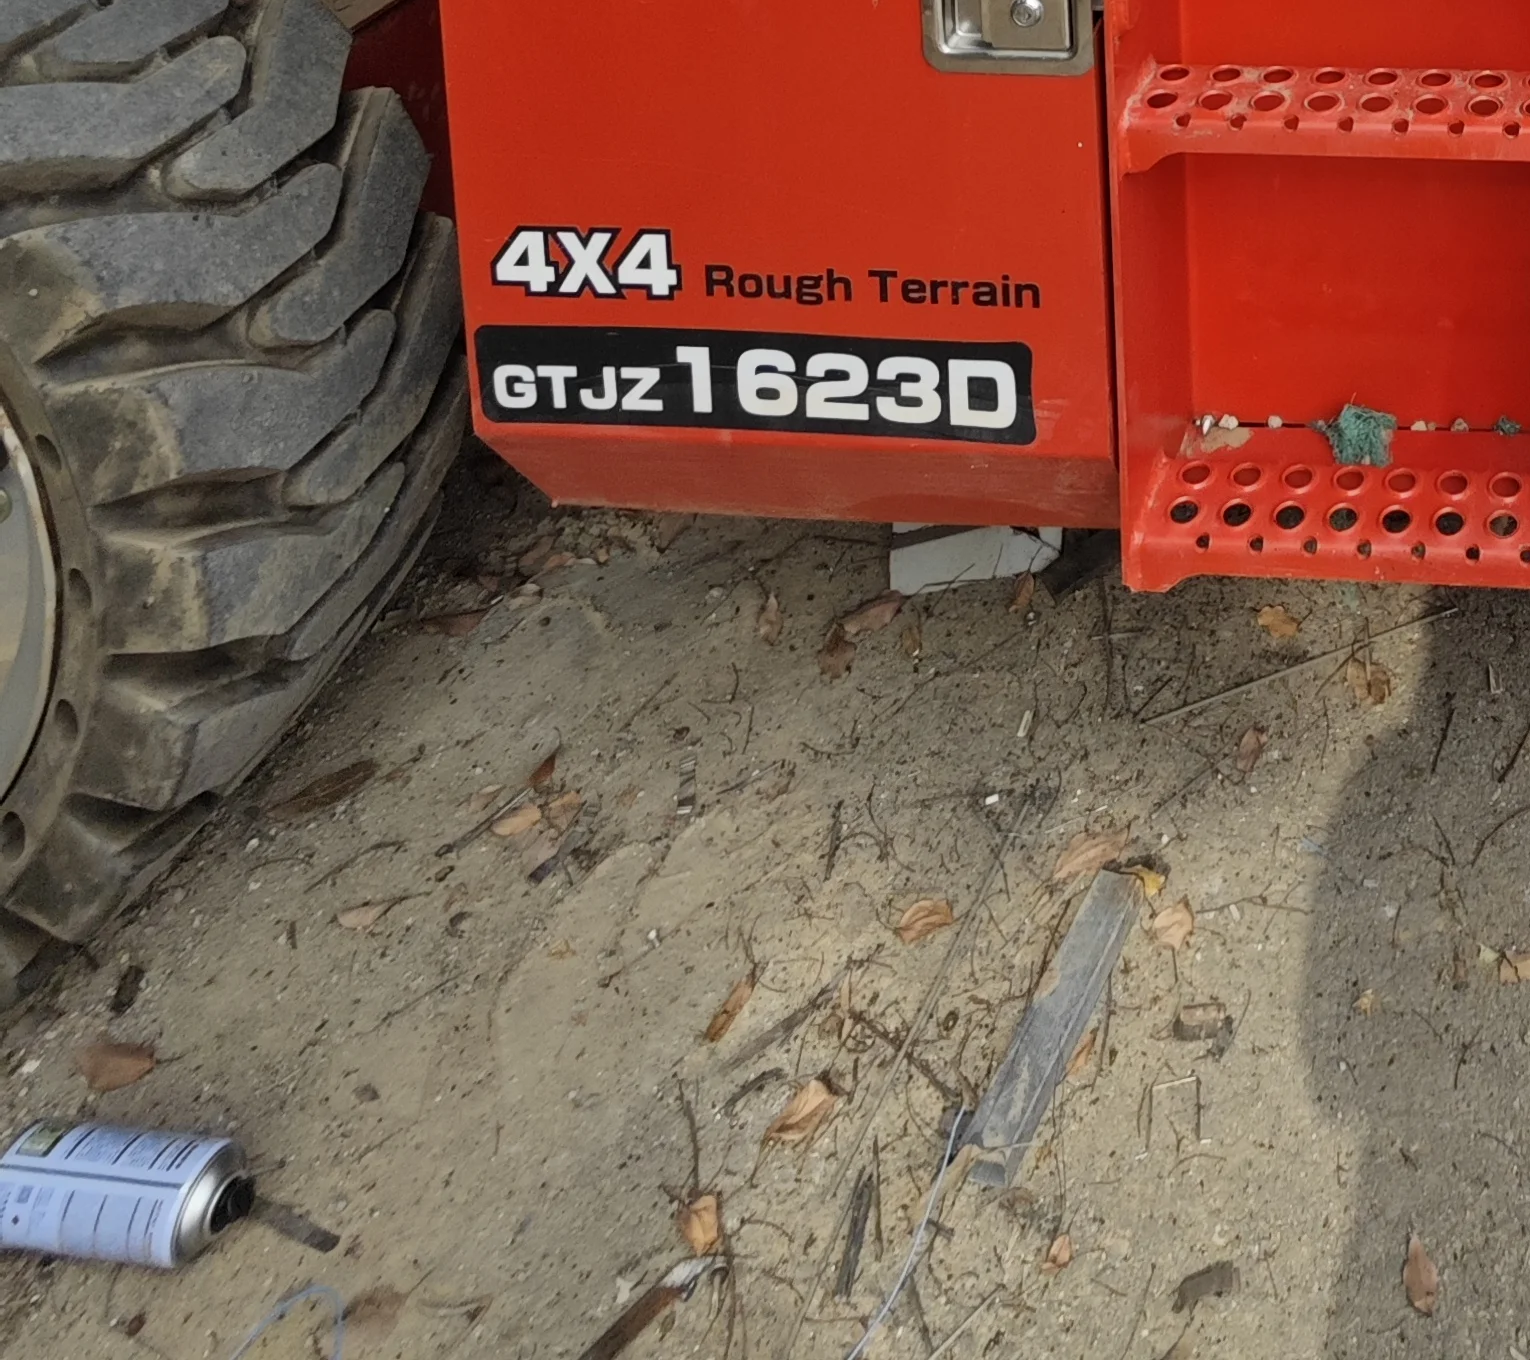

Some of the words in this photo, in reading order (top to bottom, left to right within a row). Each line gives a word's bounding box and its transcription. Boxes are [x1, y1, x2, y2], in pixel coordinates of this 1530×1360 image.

[491, 226, 682, 300] 4X4
[704, 262, 853, 306] Rough
[868, 269, 1041, 309] Terrain
[493, 346, 1017, 430] GTJZ1623D
